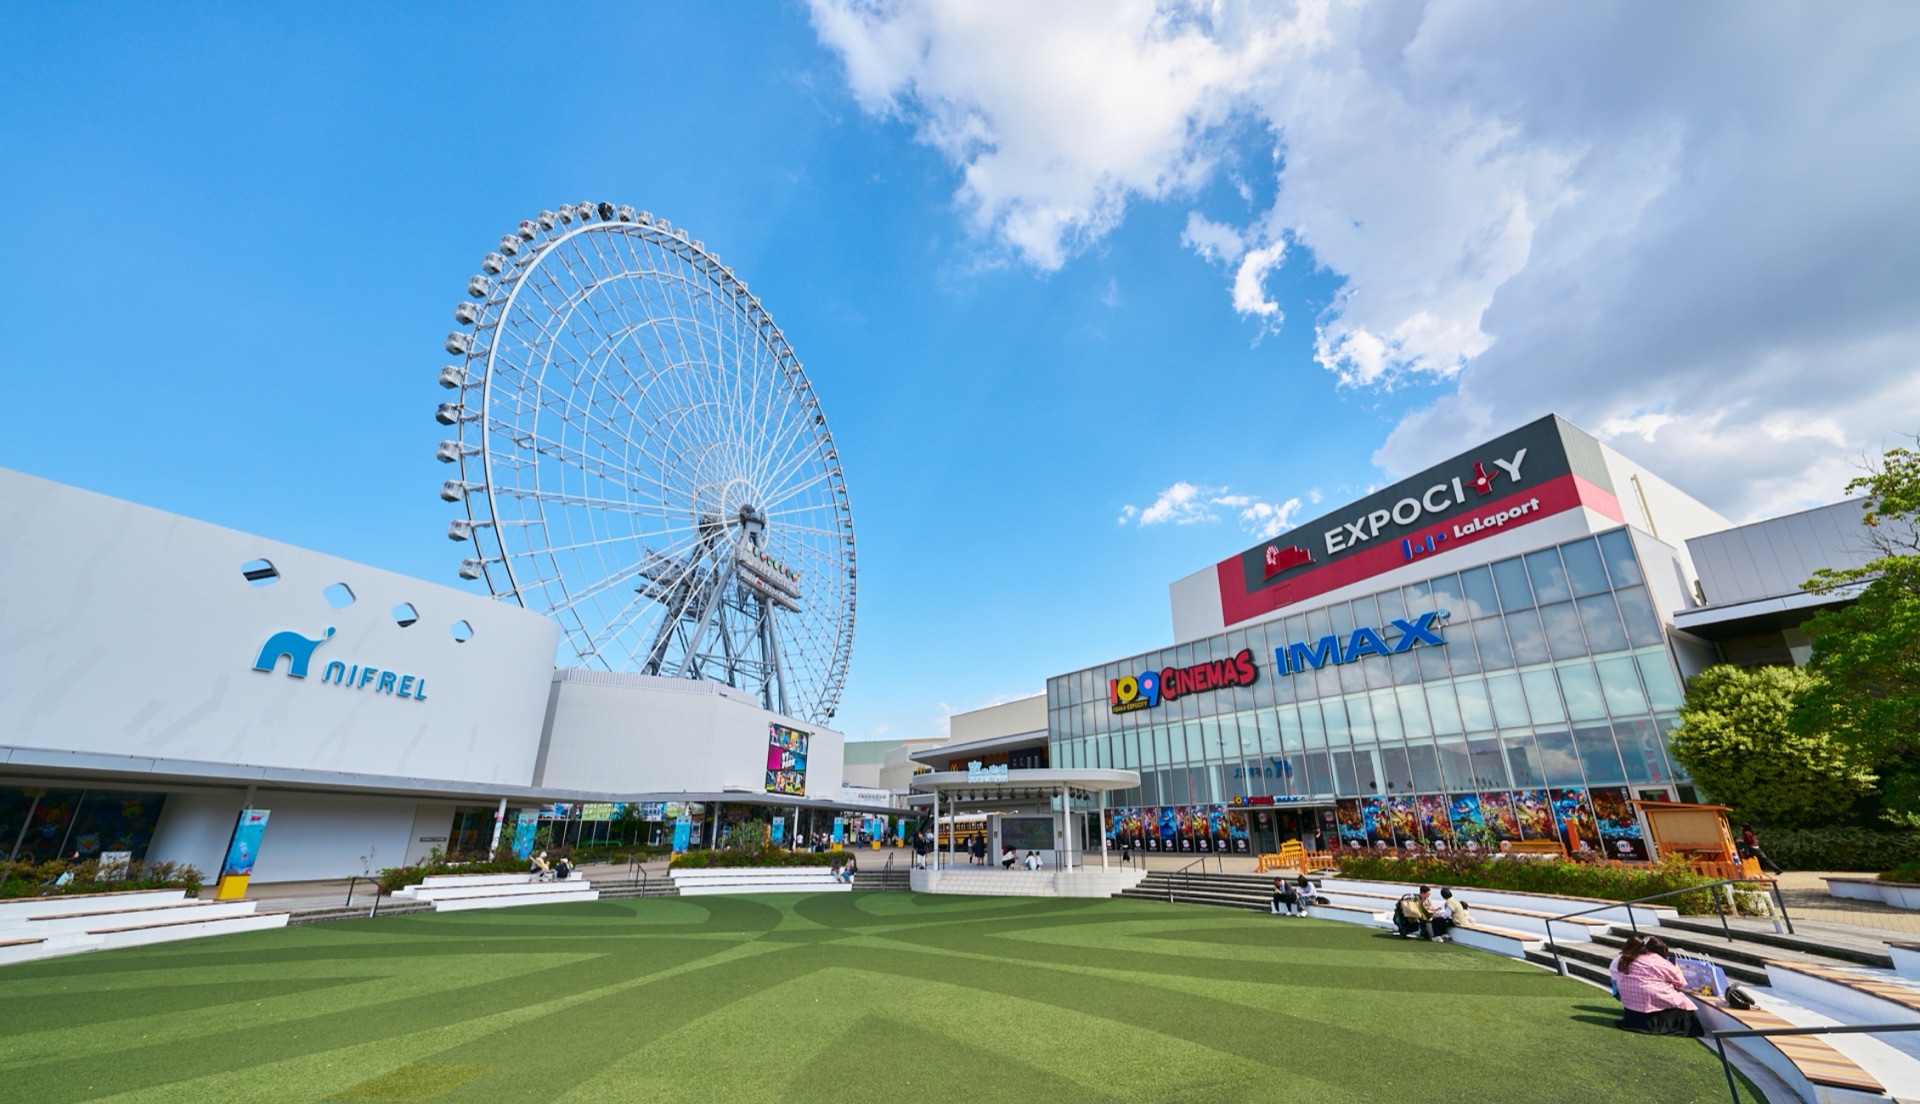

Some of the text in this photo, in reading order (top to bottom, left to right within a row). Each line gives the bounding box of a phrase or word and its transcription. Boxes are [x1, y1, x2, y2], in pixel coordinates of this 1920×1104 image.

[1324, 448, 1527, 555] EXPOCITY
[1453, 498, 1540, 538] LaLaport
[1110, 648, 1256, 707] 109 CINEMAS
